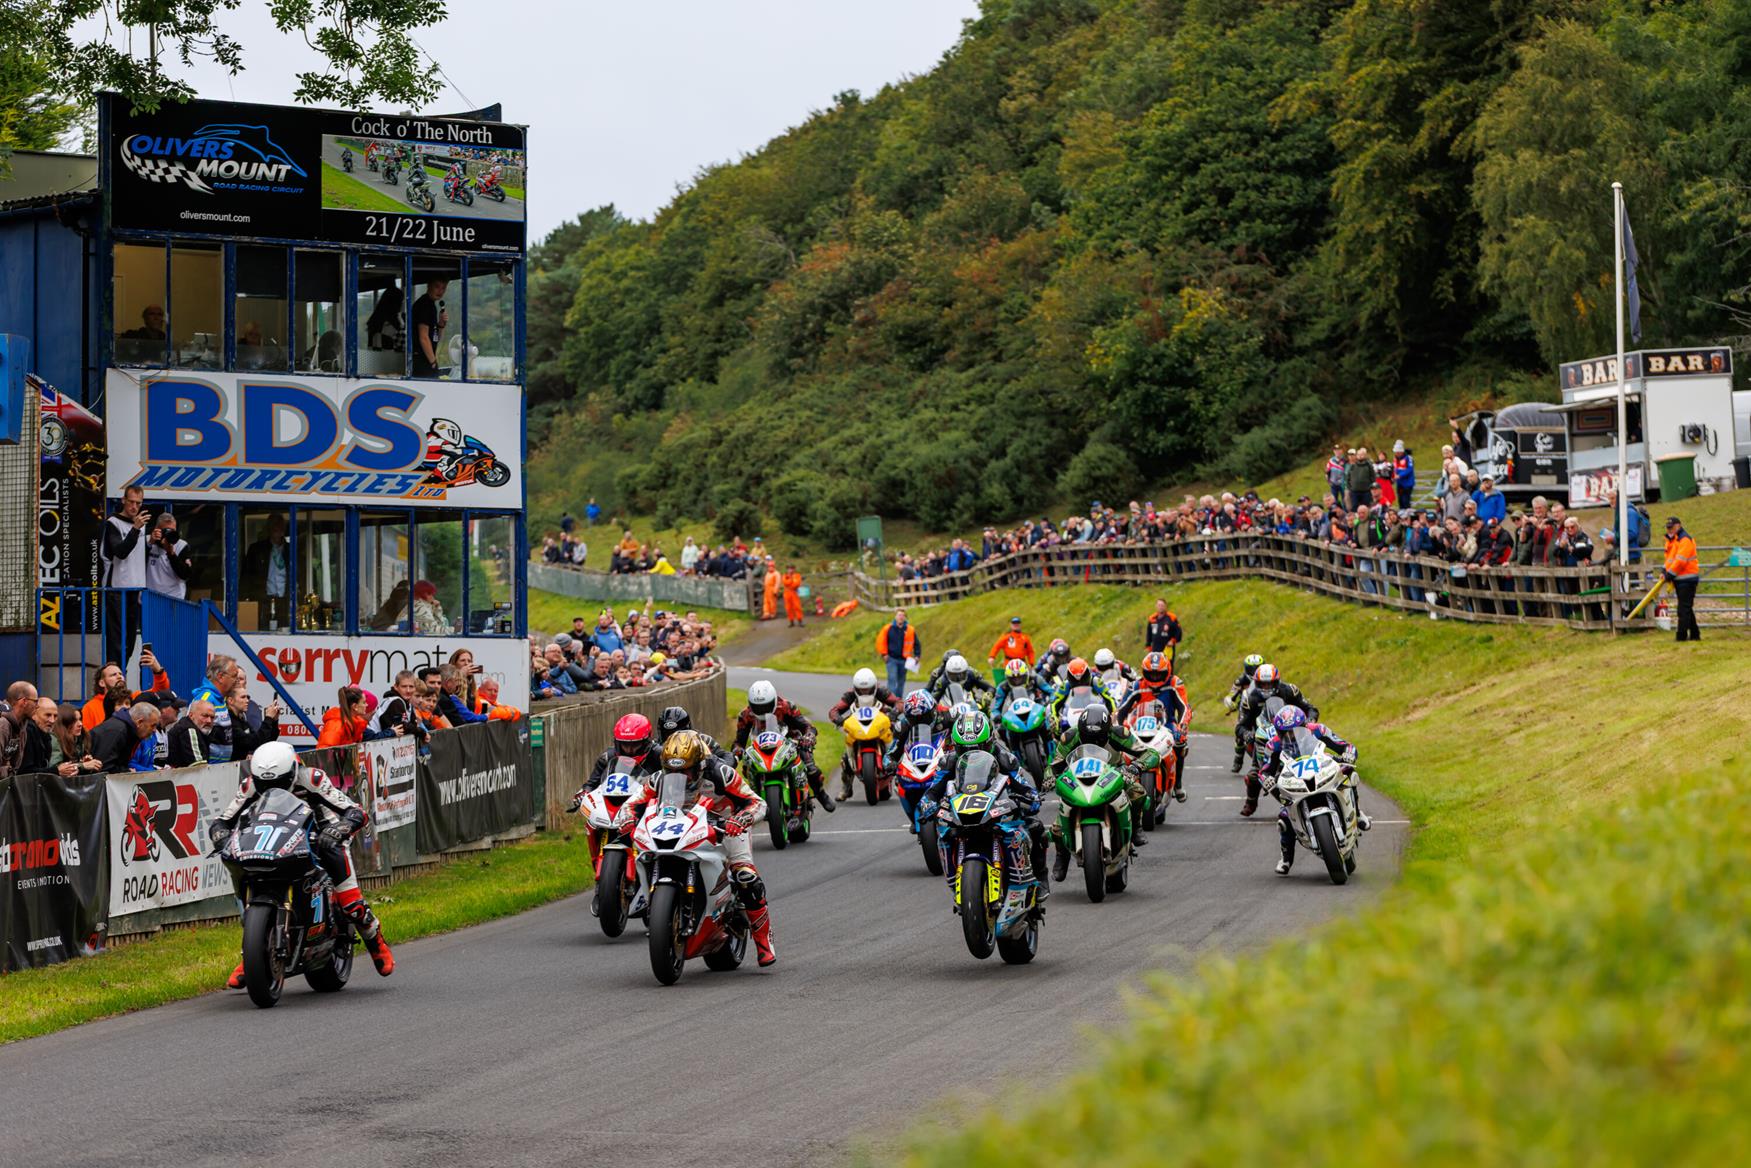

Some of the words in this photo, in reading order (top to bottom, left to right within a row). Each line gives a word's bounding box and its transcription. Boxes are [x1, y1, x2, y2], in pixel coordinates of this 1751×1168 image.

[351, 116, 389, 136] Cock
[397, 120, 410, 138] o'
[413, 121, 444, 140] The
[447, 124, 493, 144] North
[131, 134, 236, 160] OLIVERS
[195, 158, 292, 183] MOUNT
[213, 182, 237, 190] ROAD
[239, 184, 270, 192] RACING
[272, 186, 304, 194] CIRCUIT
[180, 210, 251, 223] oliversmount.com
[365, 215, 427, 243] 21/22
[431, 219, 476, 245] June
[1581, 358, 1619, 386] BAR
[1649, 354, 1705, 373] BAR
[142, 377, 426, 471] BDS
[136, 465, 426, 495] MOTORCYCLES
[412, 485, 447, 498] LTD
[39, 477, 61, 537] OILS
[90, 538, 98, 631] www.aztcoils.co.uk
[858, 707, 873, 719] 10
[1013, 700, 1030, 711] 64
[1137, 717, 1157, 731] 175
[759, 733, 777, 744] 123
[1075, 758, 1101, 775] 441
[1291, 758, 1320, 778] 74
[606, 775, 629, 793] 54
[958, 795, 991, 813] 16
[651, 821, 685, 836] 44
[254, 825, 283, 852] 71
[17, 877, 37, 890] EVENTS
[123, 874, 159, 903] ROAD
[161, 866, 199, 897] RACING
[201, 863, 228, 889] NEWS
